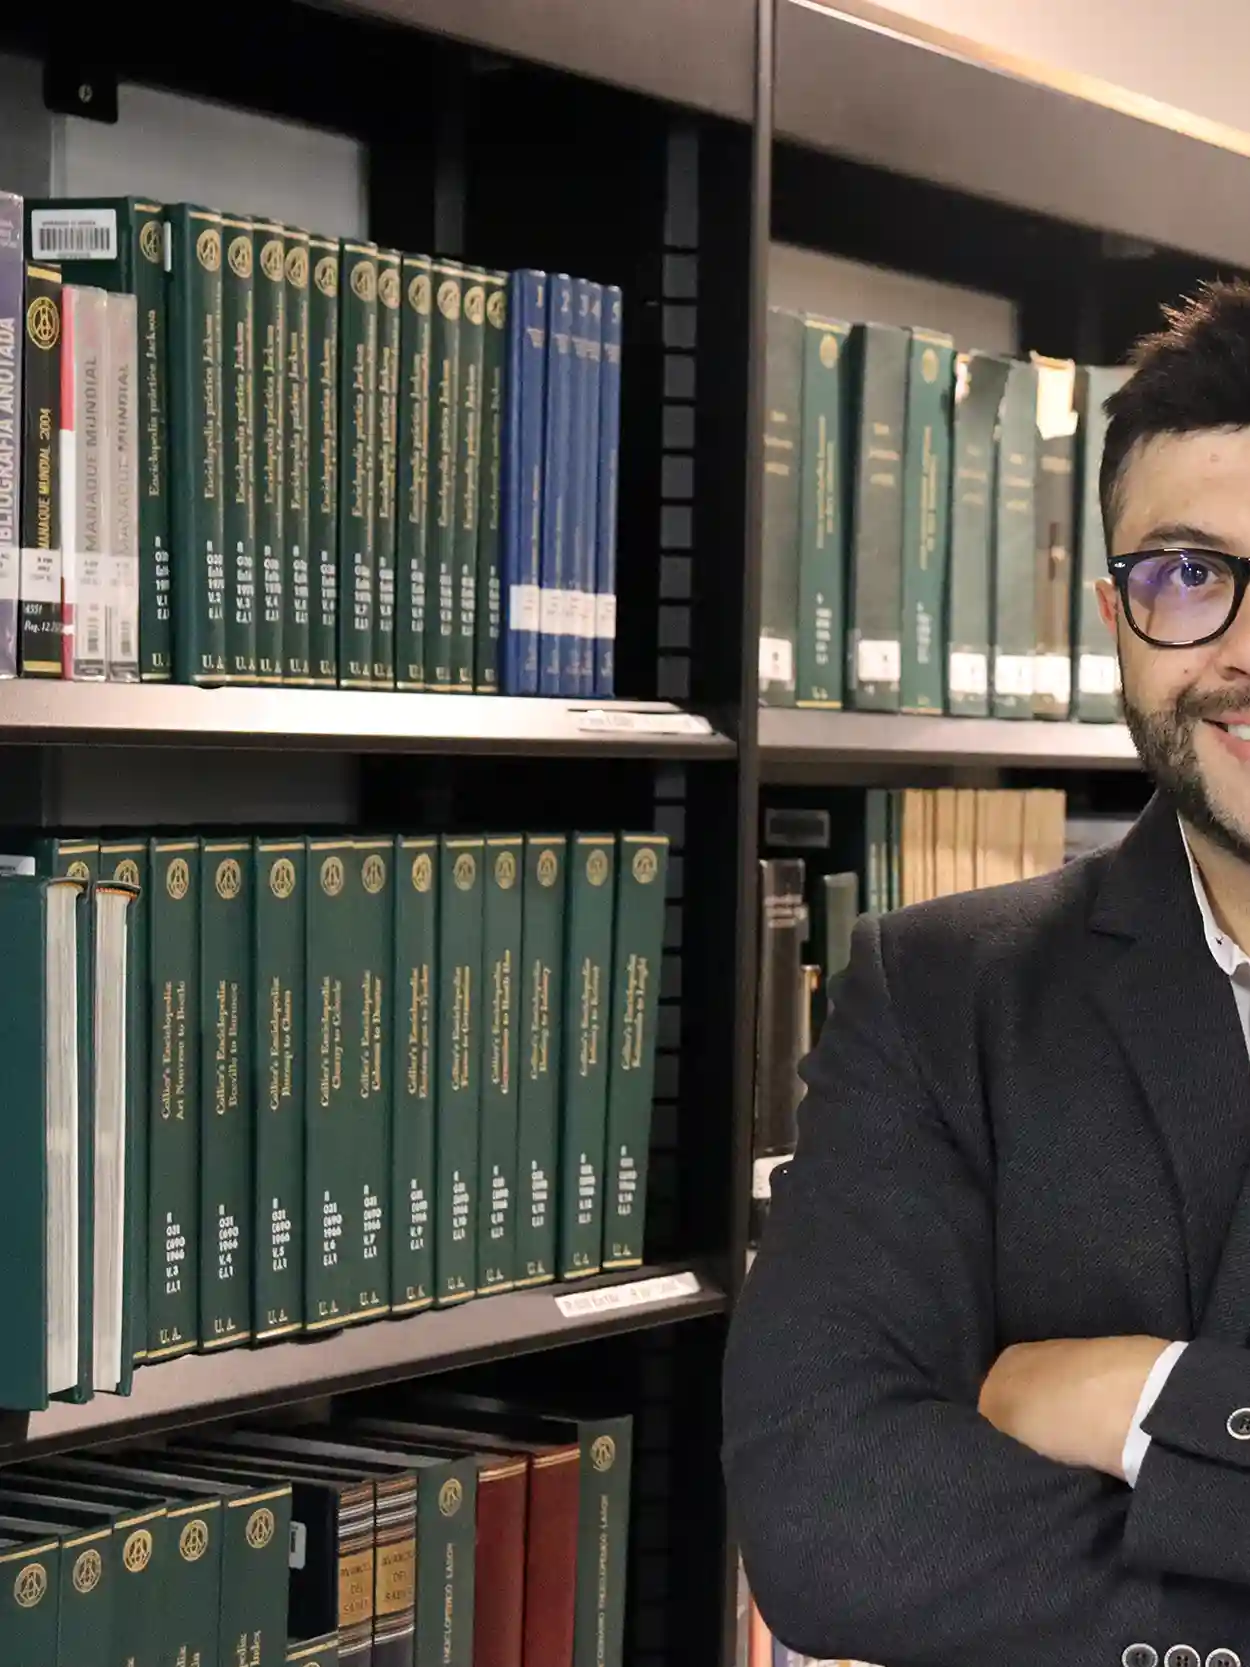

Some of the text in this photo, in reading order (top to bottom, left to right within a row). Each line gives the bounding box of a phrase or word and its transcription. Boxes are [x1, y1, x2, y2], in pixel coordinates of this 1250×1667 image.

[40, 408, 51, 441] 2004
[84, 356, 98, 448] MUNDIAL
[38, 446, 51, 494] MUNDIAL
